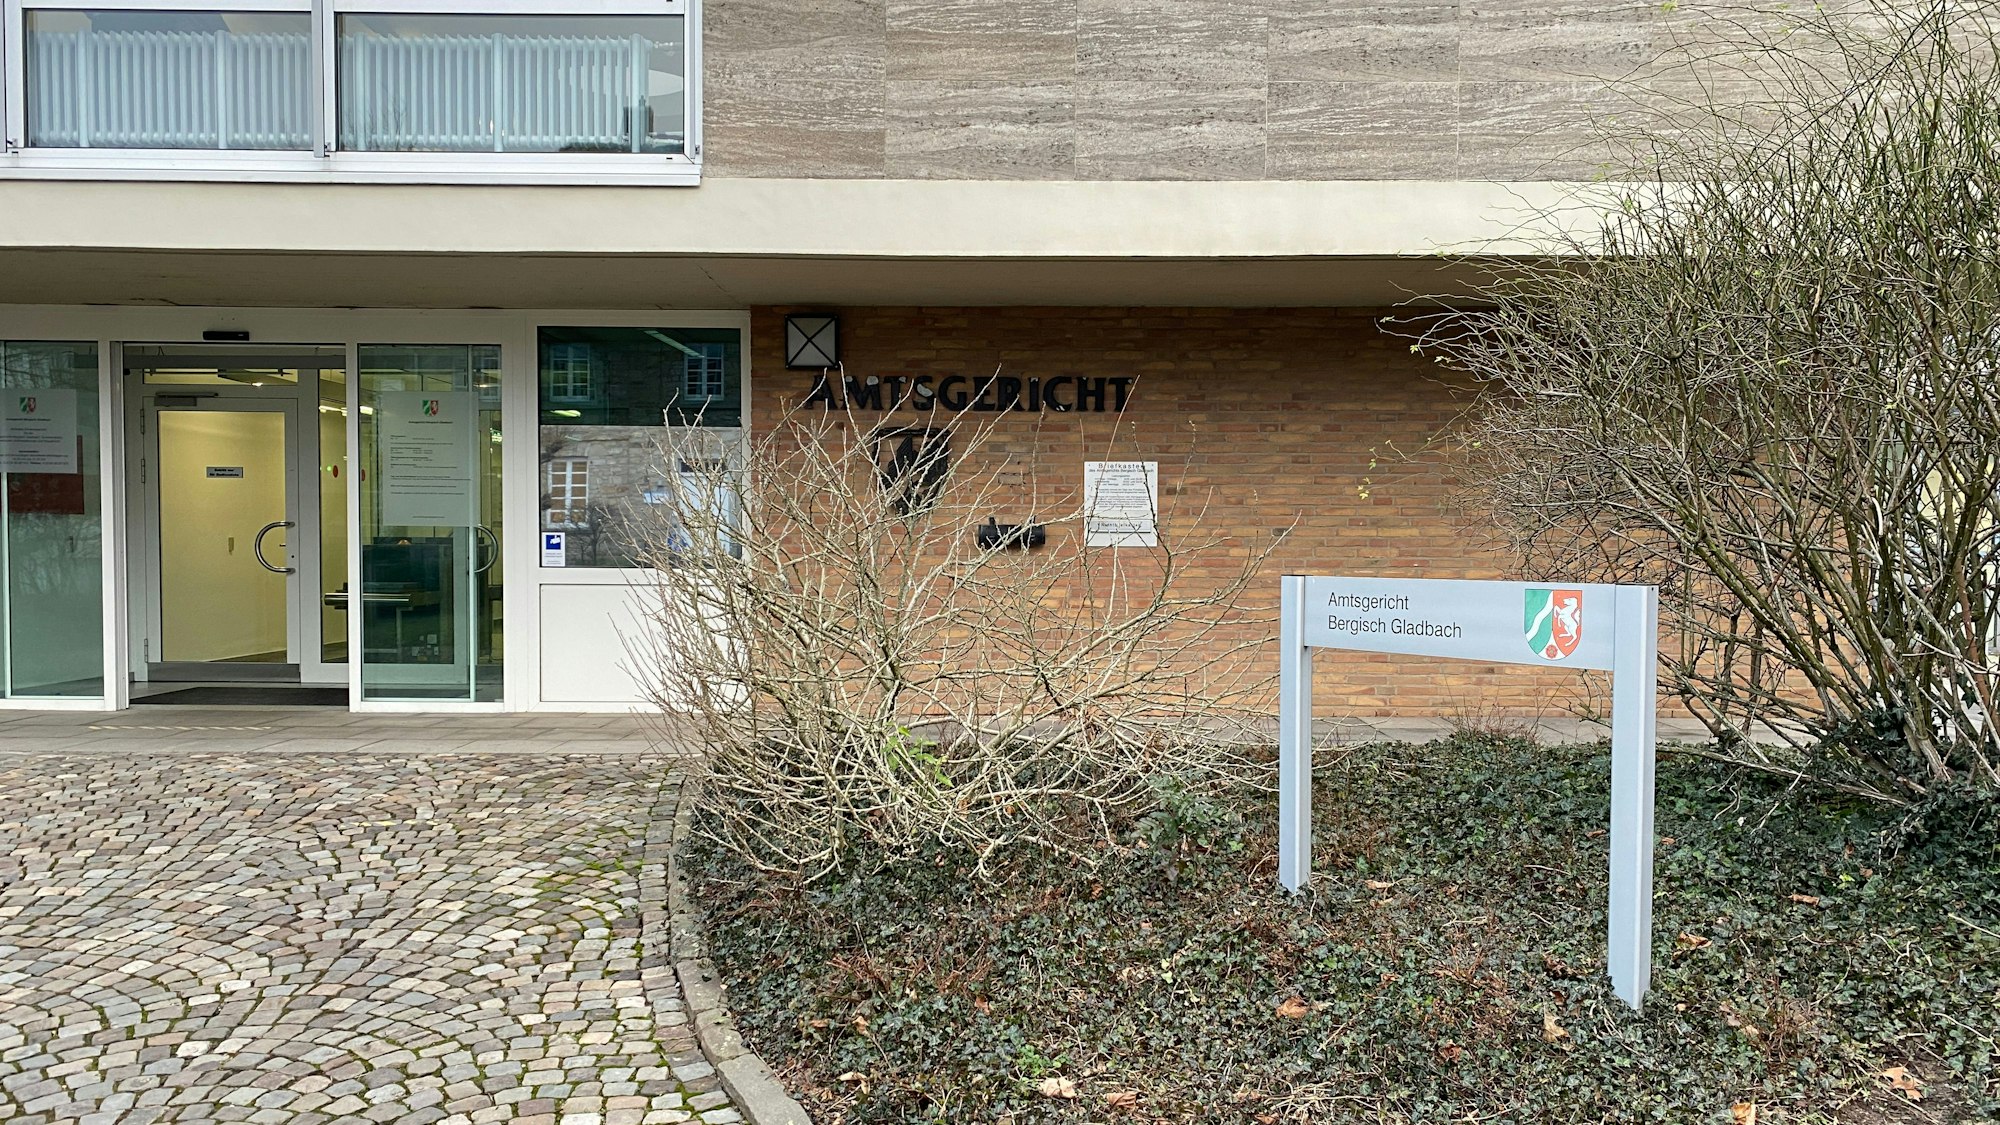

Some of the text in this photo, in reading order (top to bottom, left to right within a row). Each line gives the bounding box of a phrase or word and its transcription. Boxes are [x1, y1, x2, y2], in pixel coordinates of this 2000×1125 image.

[804, 375, 1133, 412] AMTSGERICHT
[1328, 592, 1409, 612] Amtsgericht
[1328, 615, 1462, 638] Bergisch Gladbach
